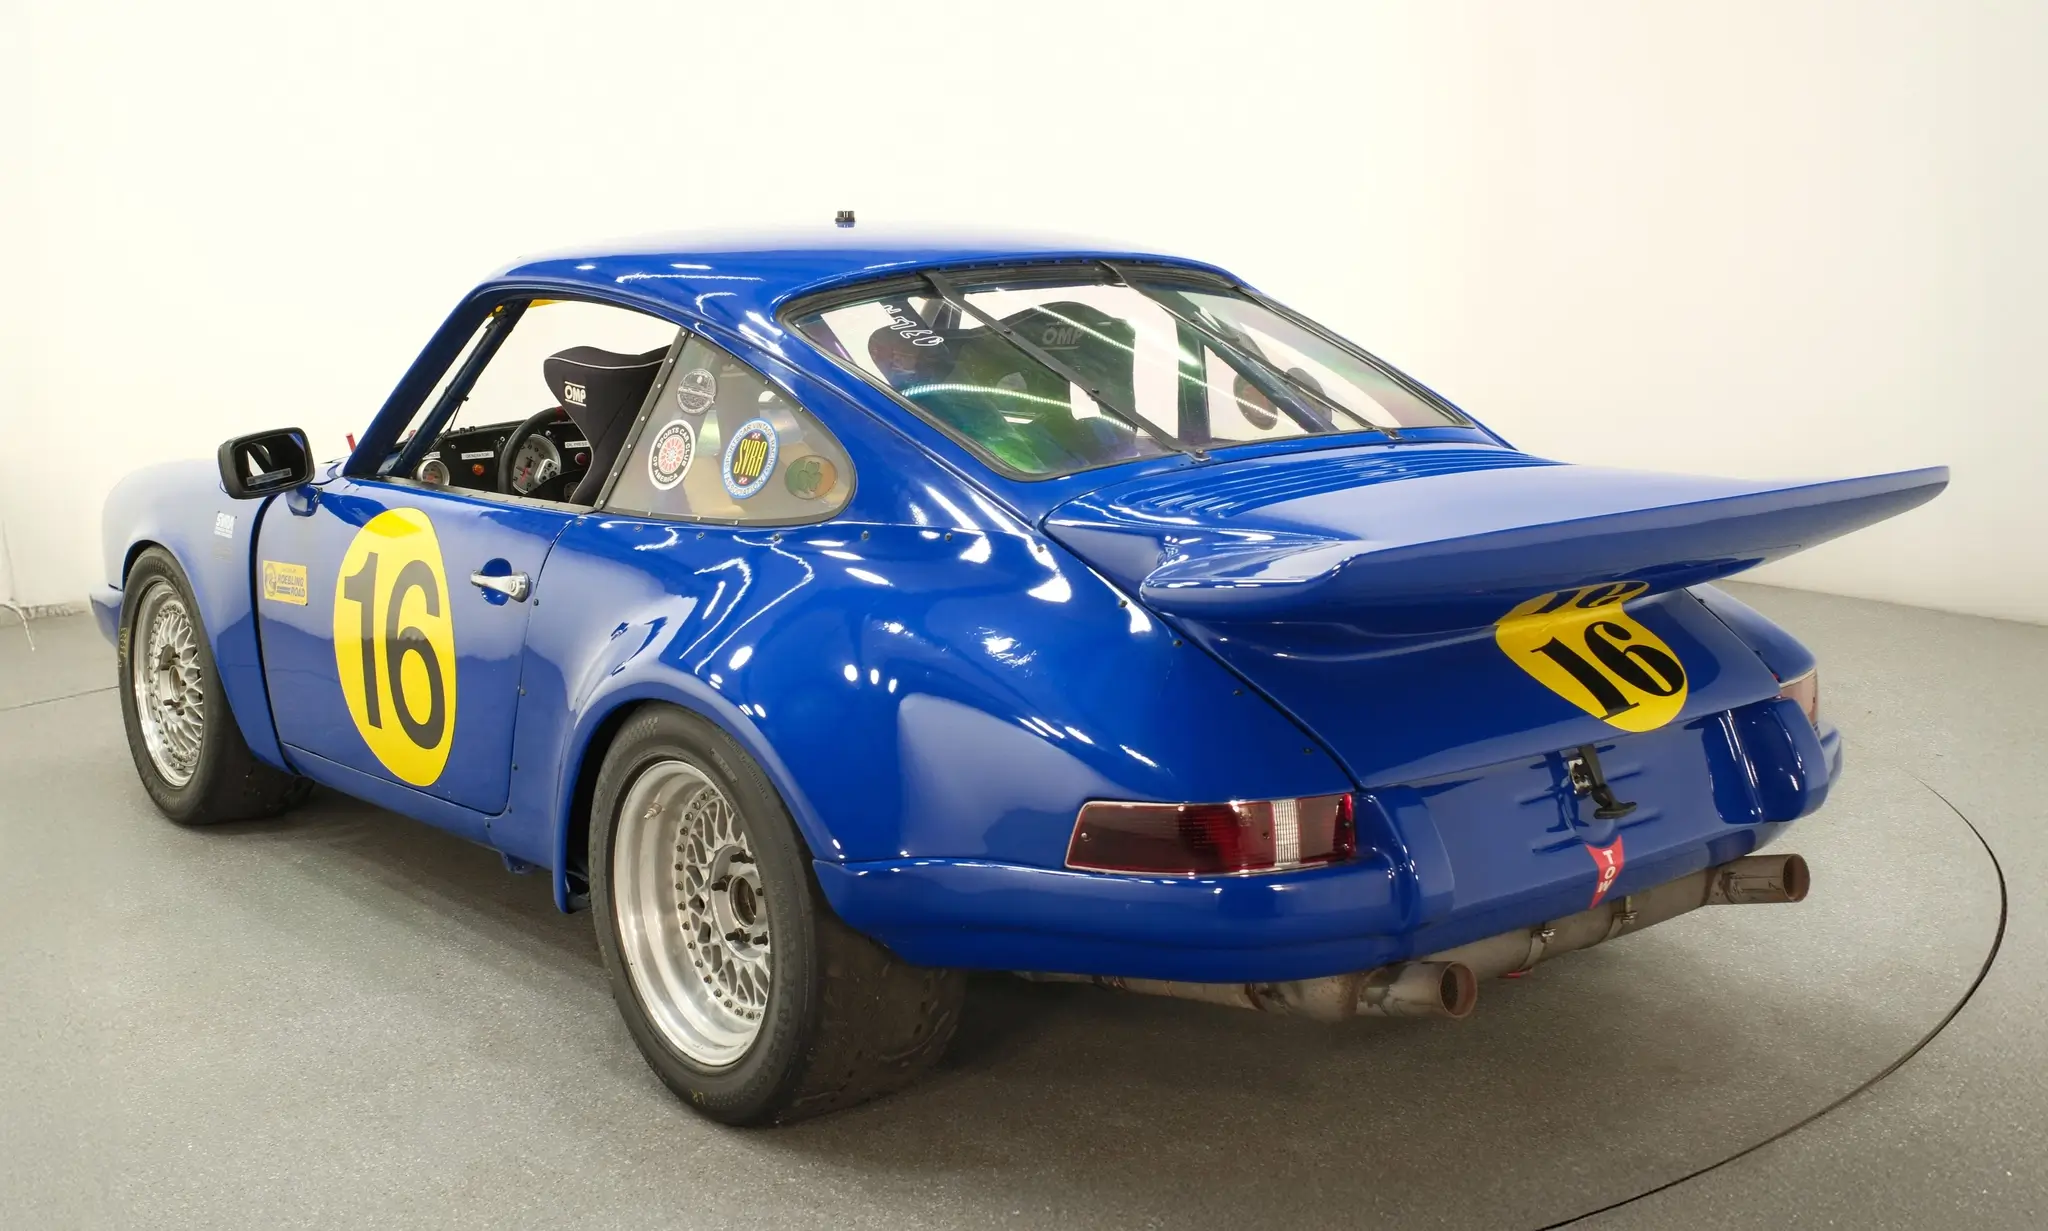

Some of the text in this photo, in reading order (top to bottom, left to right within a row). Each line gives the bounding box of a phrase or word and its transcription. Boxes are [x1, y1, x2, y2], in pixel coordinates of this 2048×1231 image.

[1042, 327, 1084, 345] OMP
[564, 385, 587, 403] OMP
[656, 427, 691, 467] SPORTS CAR CLUB
[733, 438, 768, 478] SVRA
[654, 469, 678, 483] AMERICA
[277, 574, 305, 587] ROEBLING
[290, 586, 306, 598] ROAD
[344, 551, 446, 750] 16
[1530, 621, 1685, 720] 16
[1597, 849, 1616, 893] TOW
